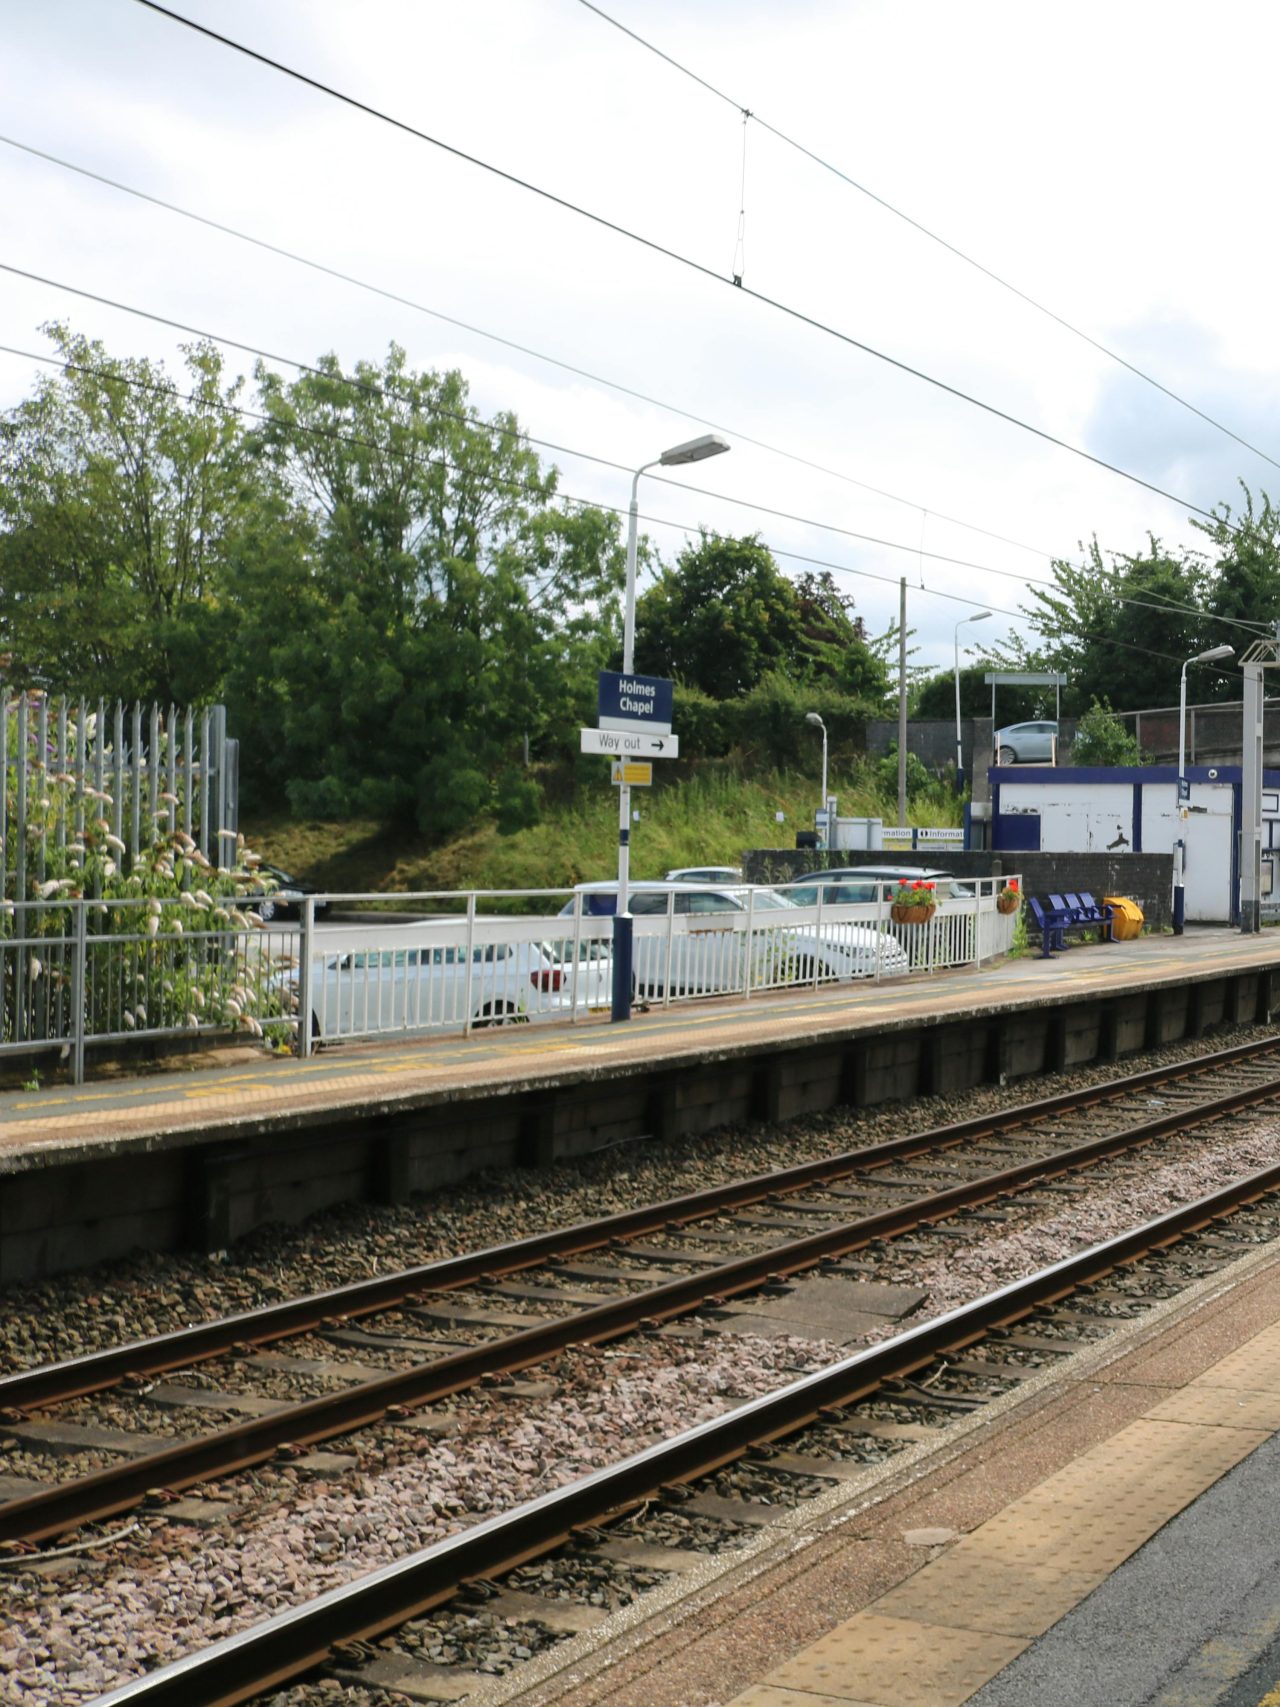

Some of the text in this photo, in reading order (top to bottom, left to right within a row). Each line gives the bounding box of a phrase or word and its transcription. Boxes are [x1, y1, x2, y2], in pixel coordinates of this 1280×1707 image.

[619, 679, 656, 697] Holmes
[619, 696, 654, 716] Chapel
[599, 734, 641, 751] Way out
